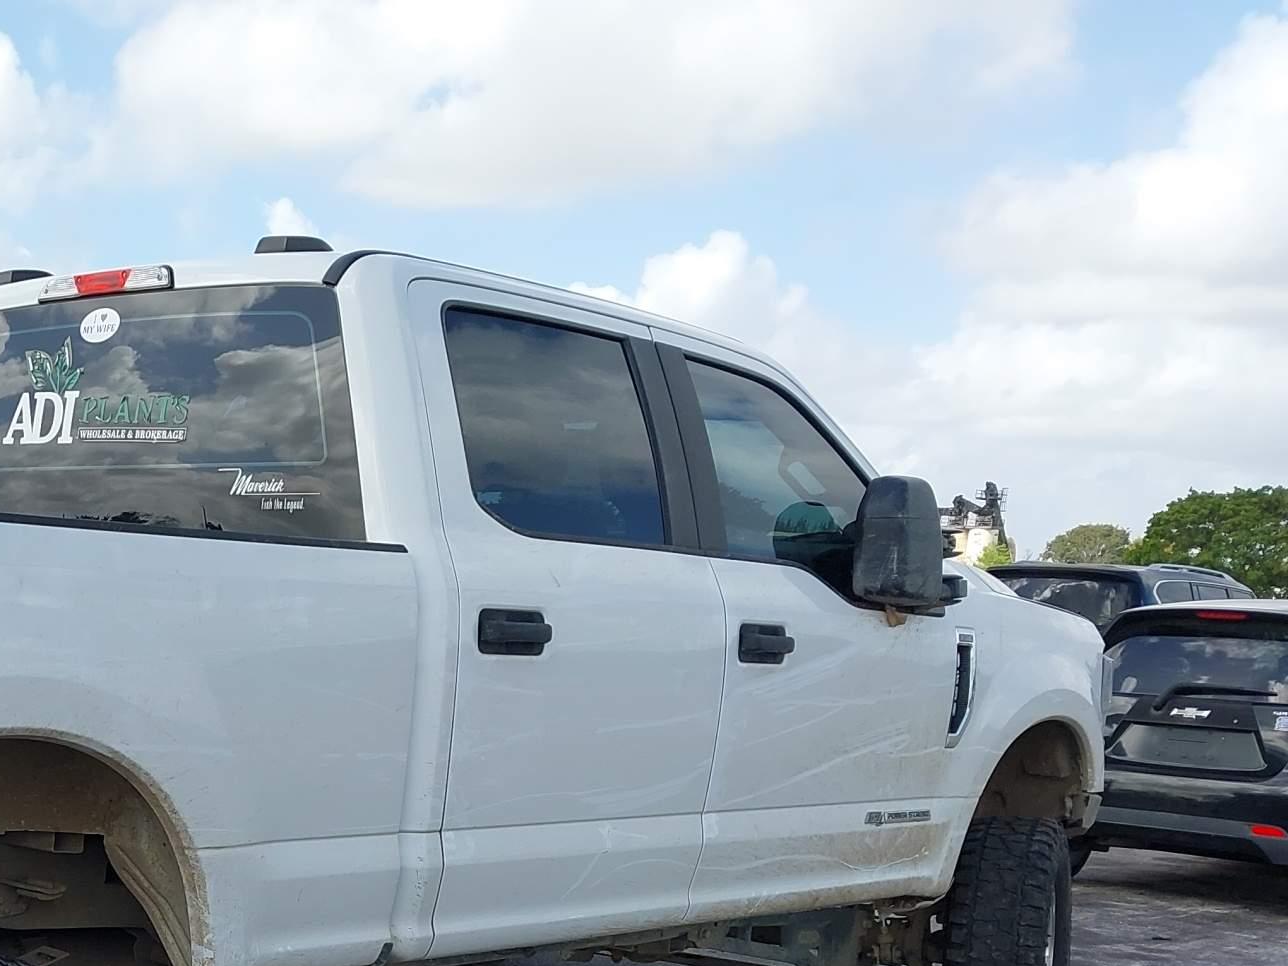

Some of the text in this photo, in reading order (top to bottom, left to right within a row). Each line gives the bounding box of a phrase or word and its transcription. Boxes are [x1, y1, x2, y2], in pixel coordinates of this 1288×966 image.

[83, 323, 117, 334] MY WIFE
[2, 390, 80, 445] ADI
[79, 429, 184, 440] WHOLESALE & BROKERAGE
[220, 469, 285, 496] Maverick
